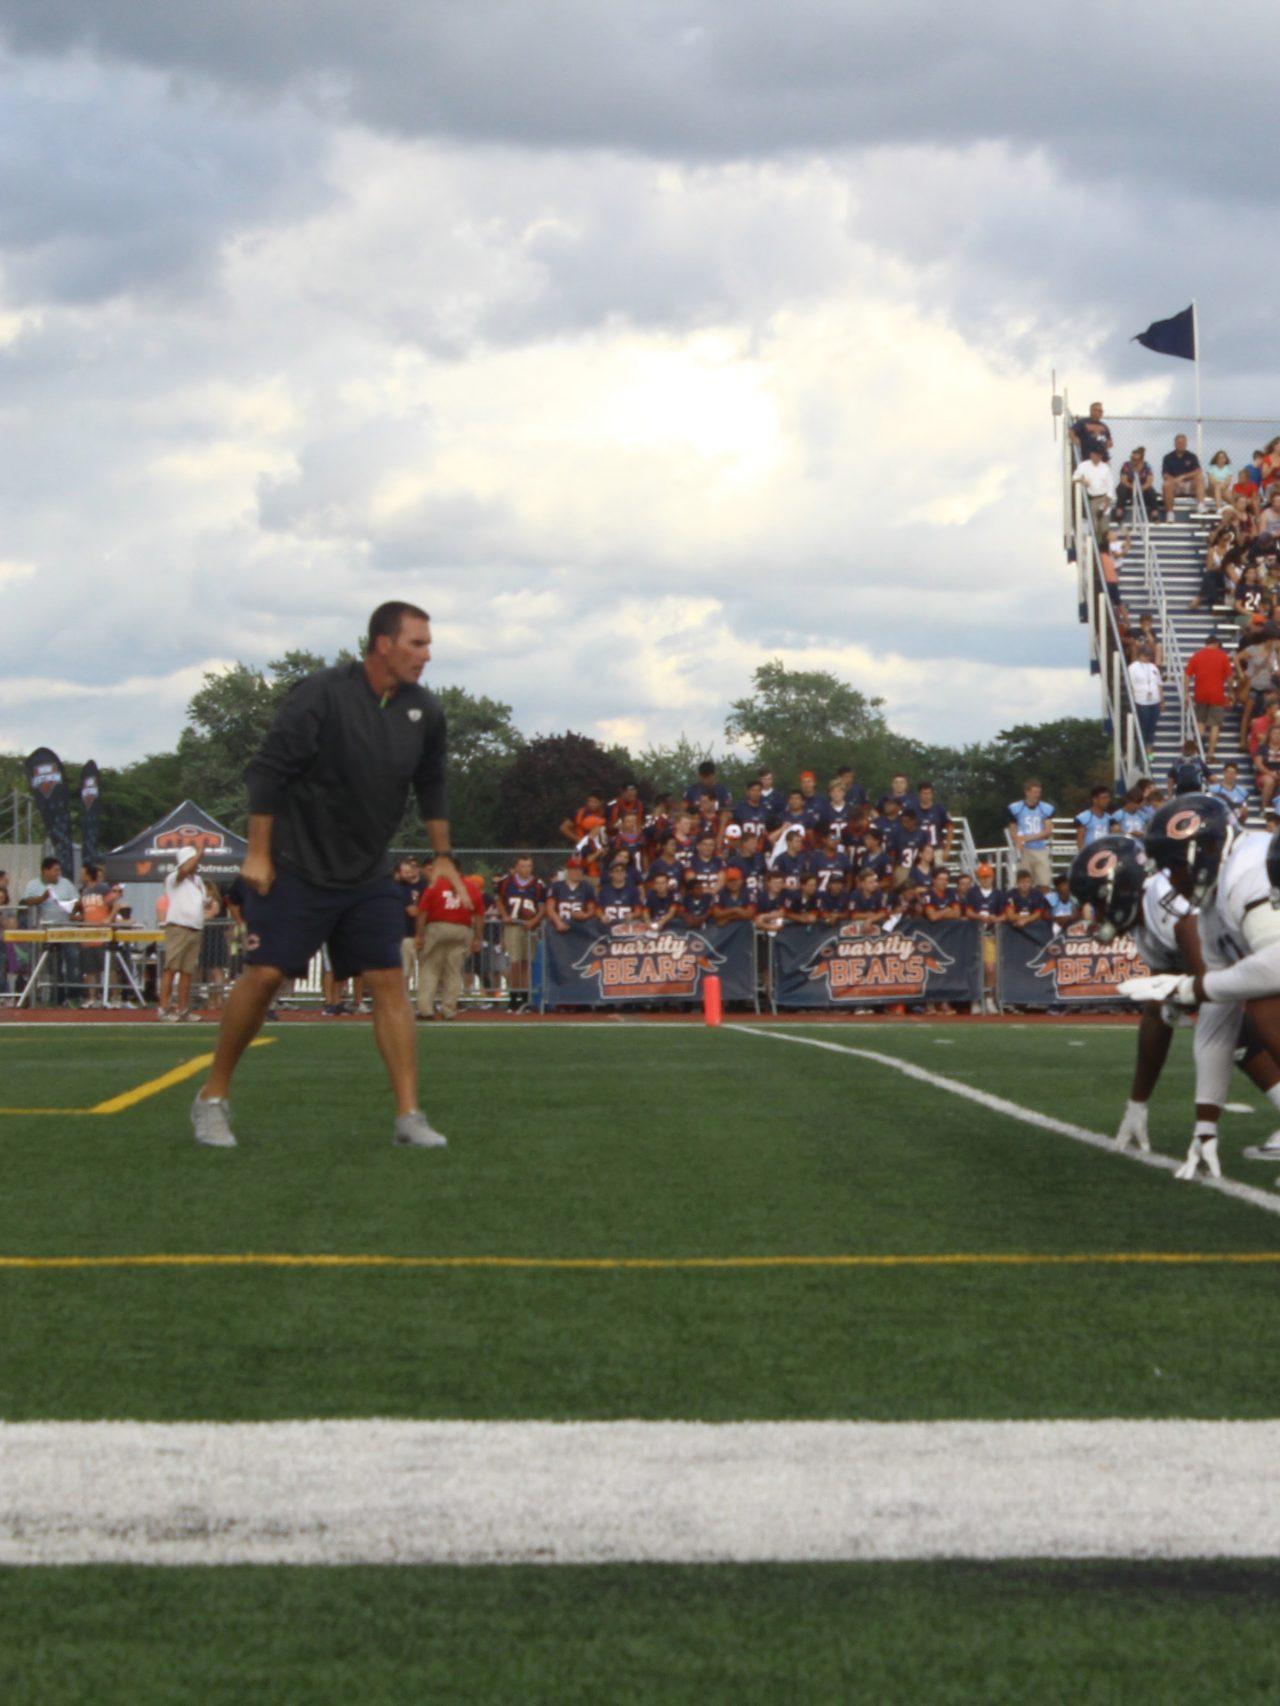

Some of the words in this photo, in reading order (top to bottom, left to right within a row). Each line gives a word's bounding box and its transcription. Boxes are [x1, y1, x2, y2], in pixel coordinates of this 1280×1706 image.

[1245, 591, 1261, 610] 24
[1024, 816, 1042, 834] 50
[611, 936, 687, 959] varsity
[838, 936, 915, 960] varsity
[603, 955, 697, 984] BEARS
[829, 955, 924, 986] BEARS
[1057, 955, 1151, 984] BEARS
